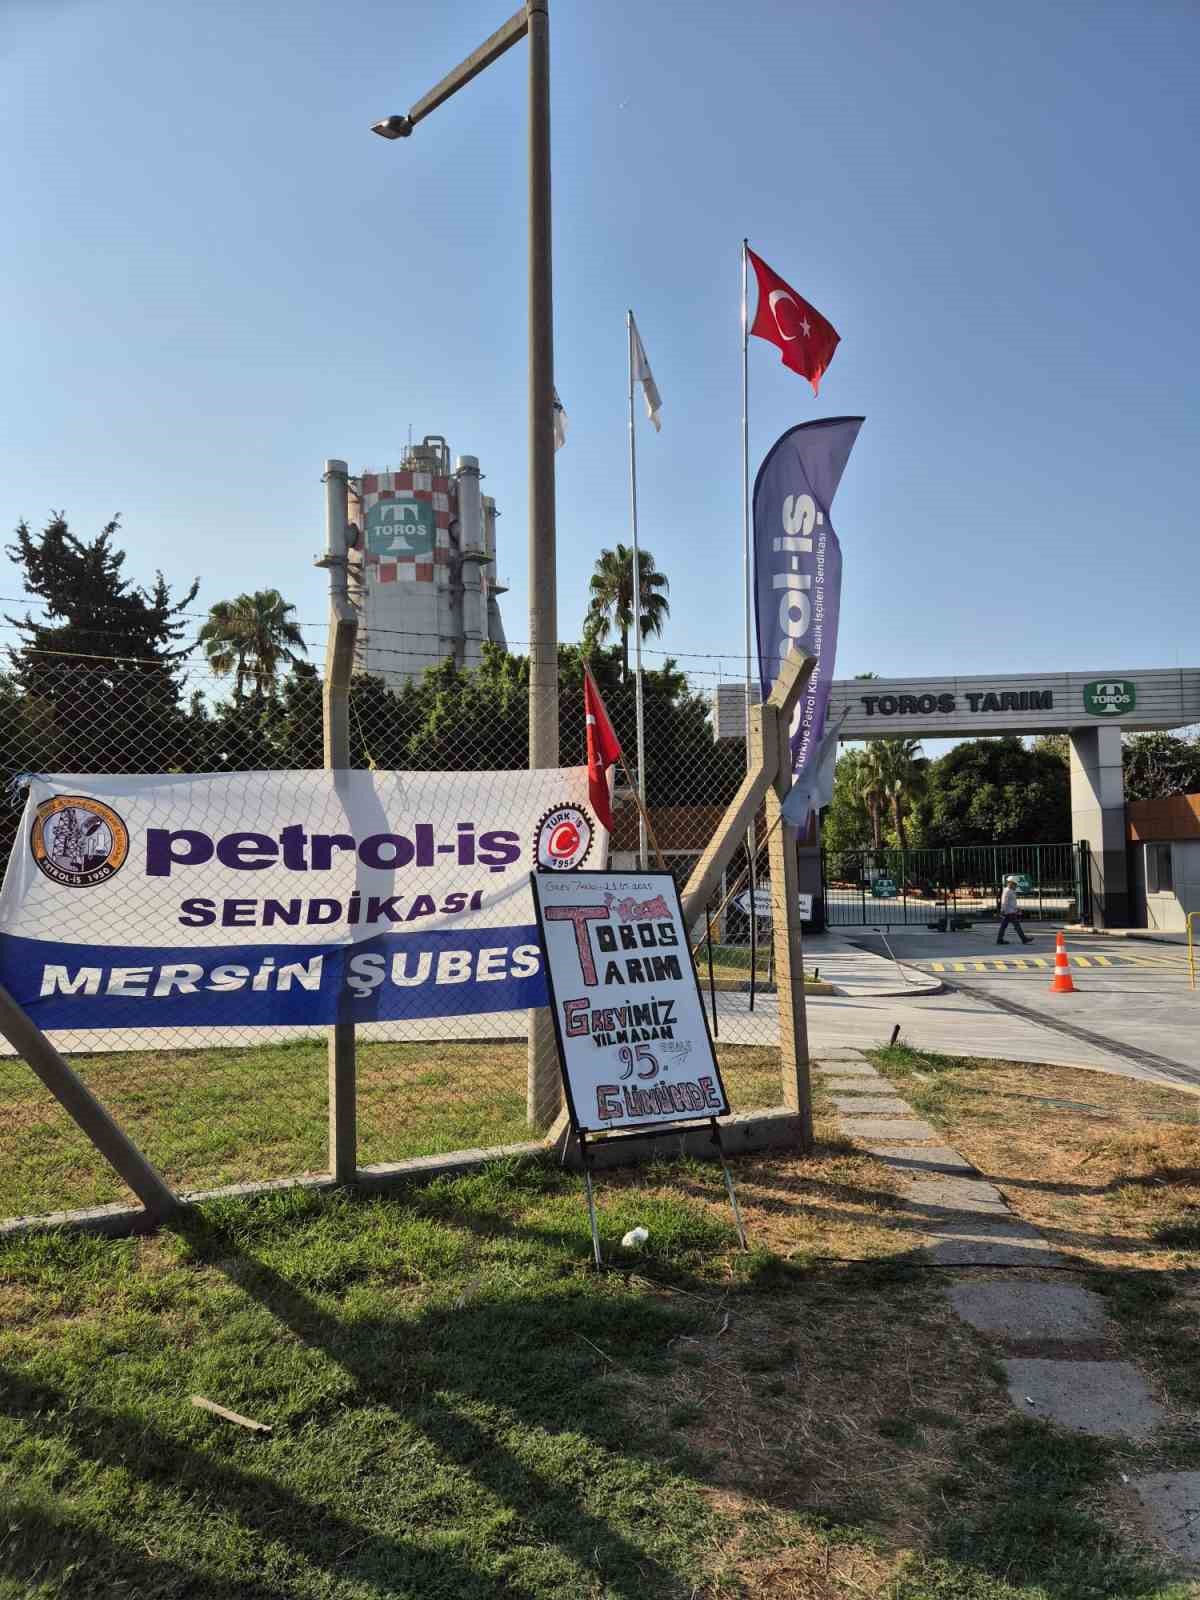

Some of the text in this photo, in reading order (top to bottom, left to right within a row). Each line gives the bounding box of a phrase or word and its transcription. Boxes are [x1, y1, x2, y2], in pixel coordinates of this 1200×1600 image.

[375, 524, 427, 536] TOROS
[802, 696, 816, 729] Petrol
[815, 533, 827, 584] Sendikası
[861, 689, 1053, 716] TOROS TARIM
[1090, 694, 1131, 704] TOROS
[146, 822, 521, 876] petrol-iş
[87, 867, 110, 882] 1950
[178, 890, 484, 927] SENDİKASI
[40, 945, 541, 998] MERSİN ŞUBES
[563, 996, 677, 1037] GREVİMİZ
[592, 1025, 674, 1047] YILMADAN
[596, 1076, 721, 1120] GÜNÜNDE
